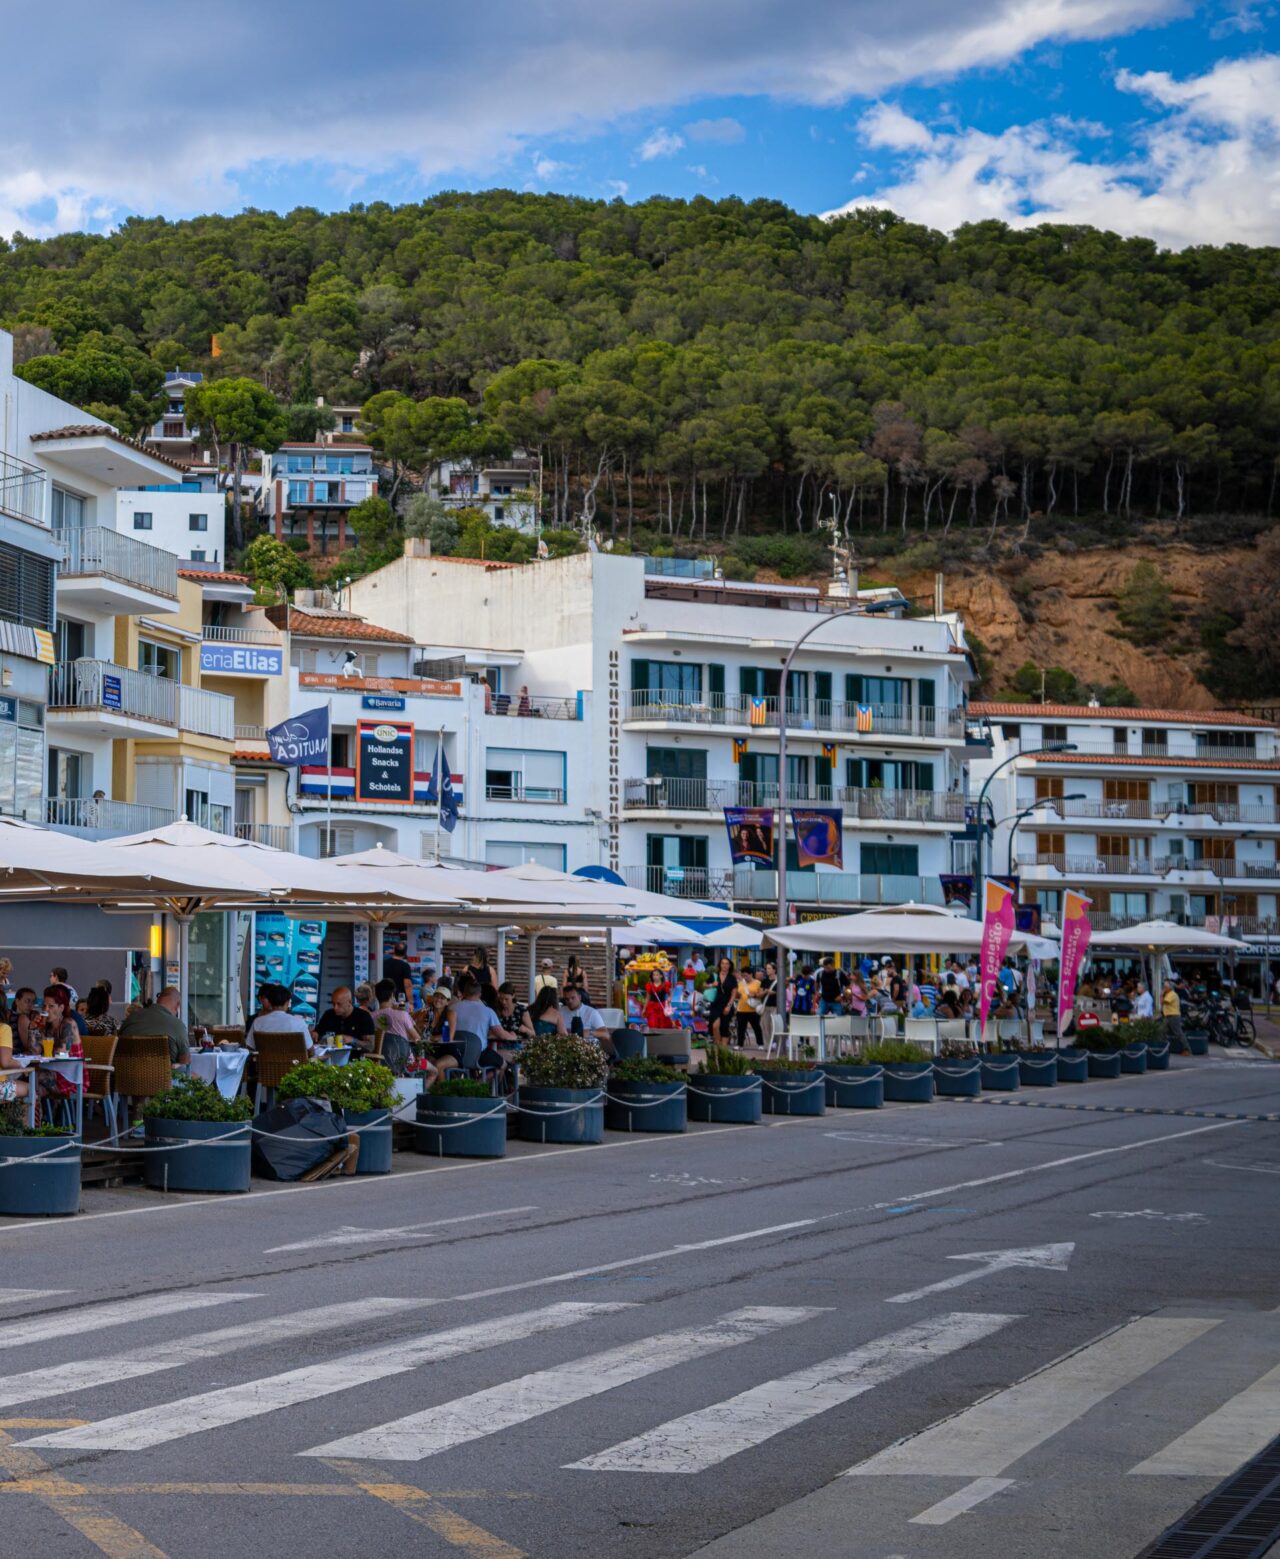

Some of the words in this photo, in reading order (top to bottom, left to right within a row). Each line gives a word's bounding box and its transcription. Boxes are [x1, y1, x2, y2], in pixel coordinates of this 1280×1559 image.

[375, 699, 402, 708] Bavaria
[367, 745, 404, 755] Hollandse
[372, 758, 399, 767] Snacks
[382, 771, 388, 779] &
[369, 782, 401, 792] Schotels
